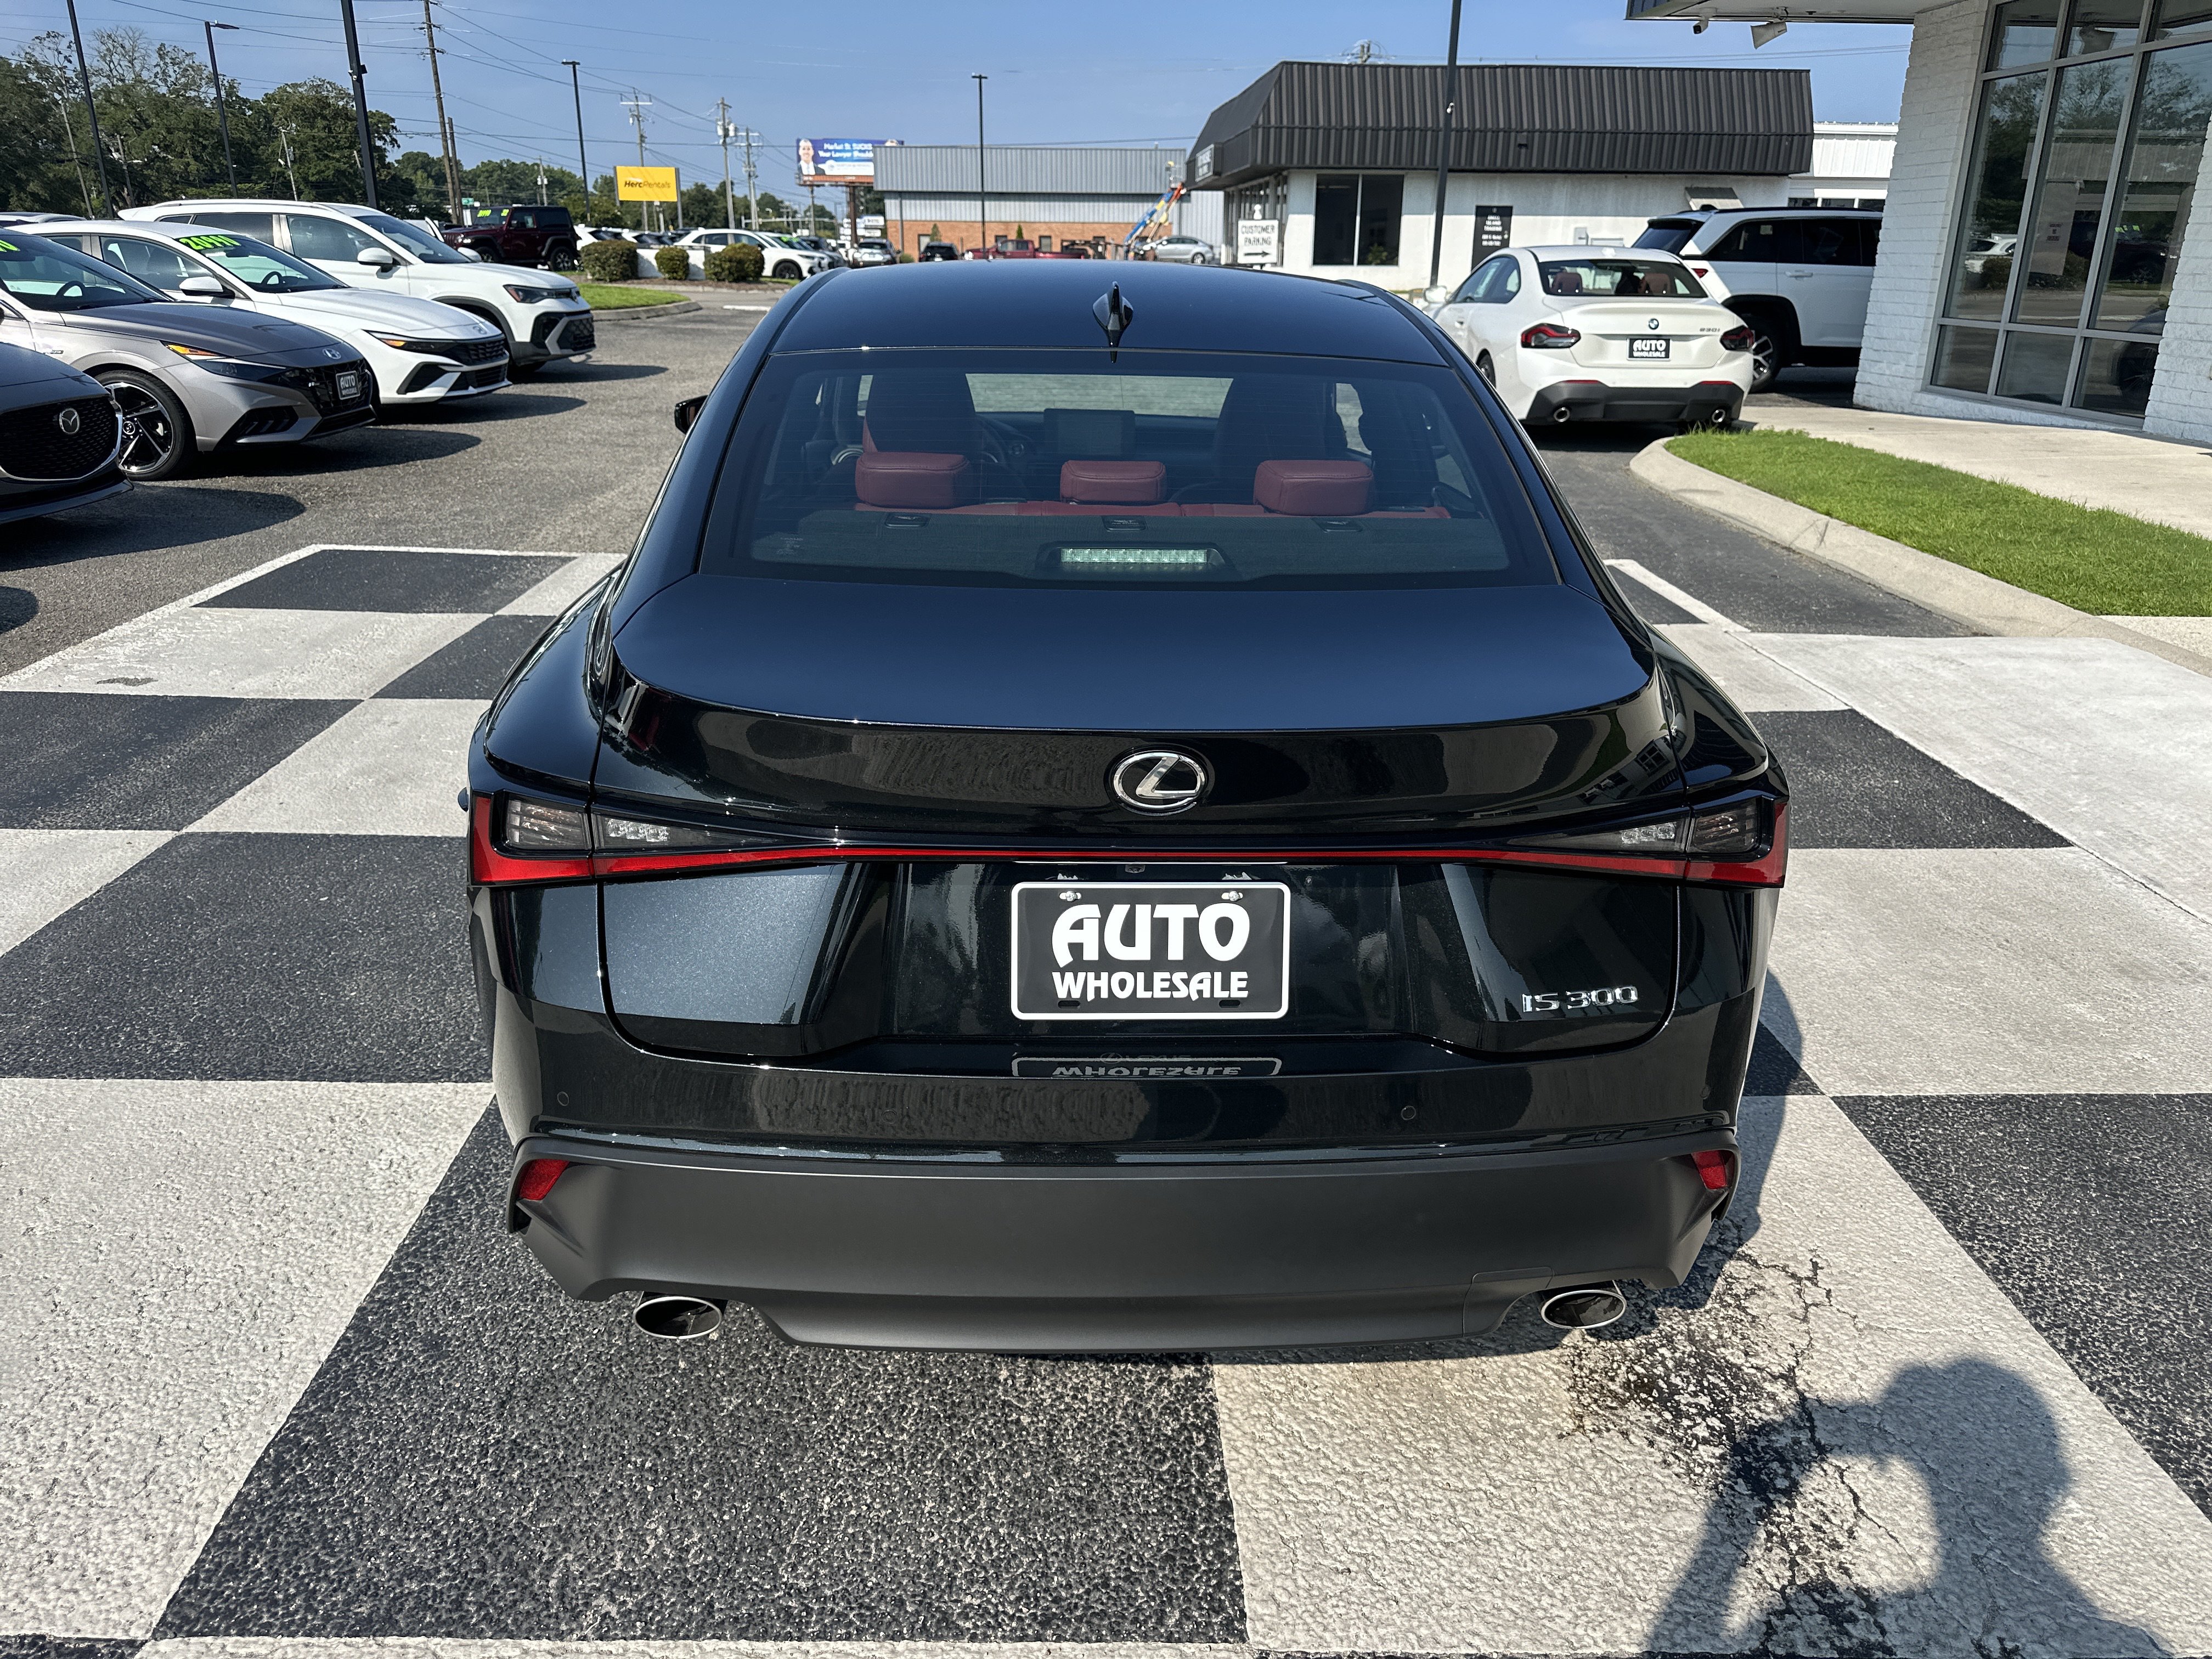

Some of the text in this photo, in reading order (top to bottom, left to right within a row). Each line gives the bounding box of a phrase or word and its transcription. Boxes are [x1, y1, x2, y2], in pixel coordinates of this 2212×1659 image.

[1240, 224, 1276, 234] CUSTOMER
[179, 235, 241, 250] 20990
[1244, 236, 1272, 246] PARKING
[1633, 340, 1666, 351] AUTO
[340, 375, 356, 389] AUTO
[1052, 902, 1250, 968] AUTO
[1052, 971, 1249, 1002] WHOLESALE
[1522, 985, 1638, 1013] IS 300
